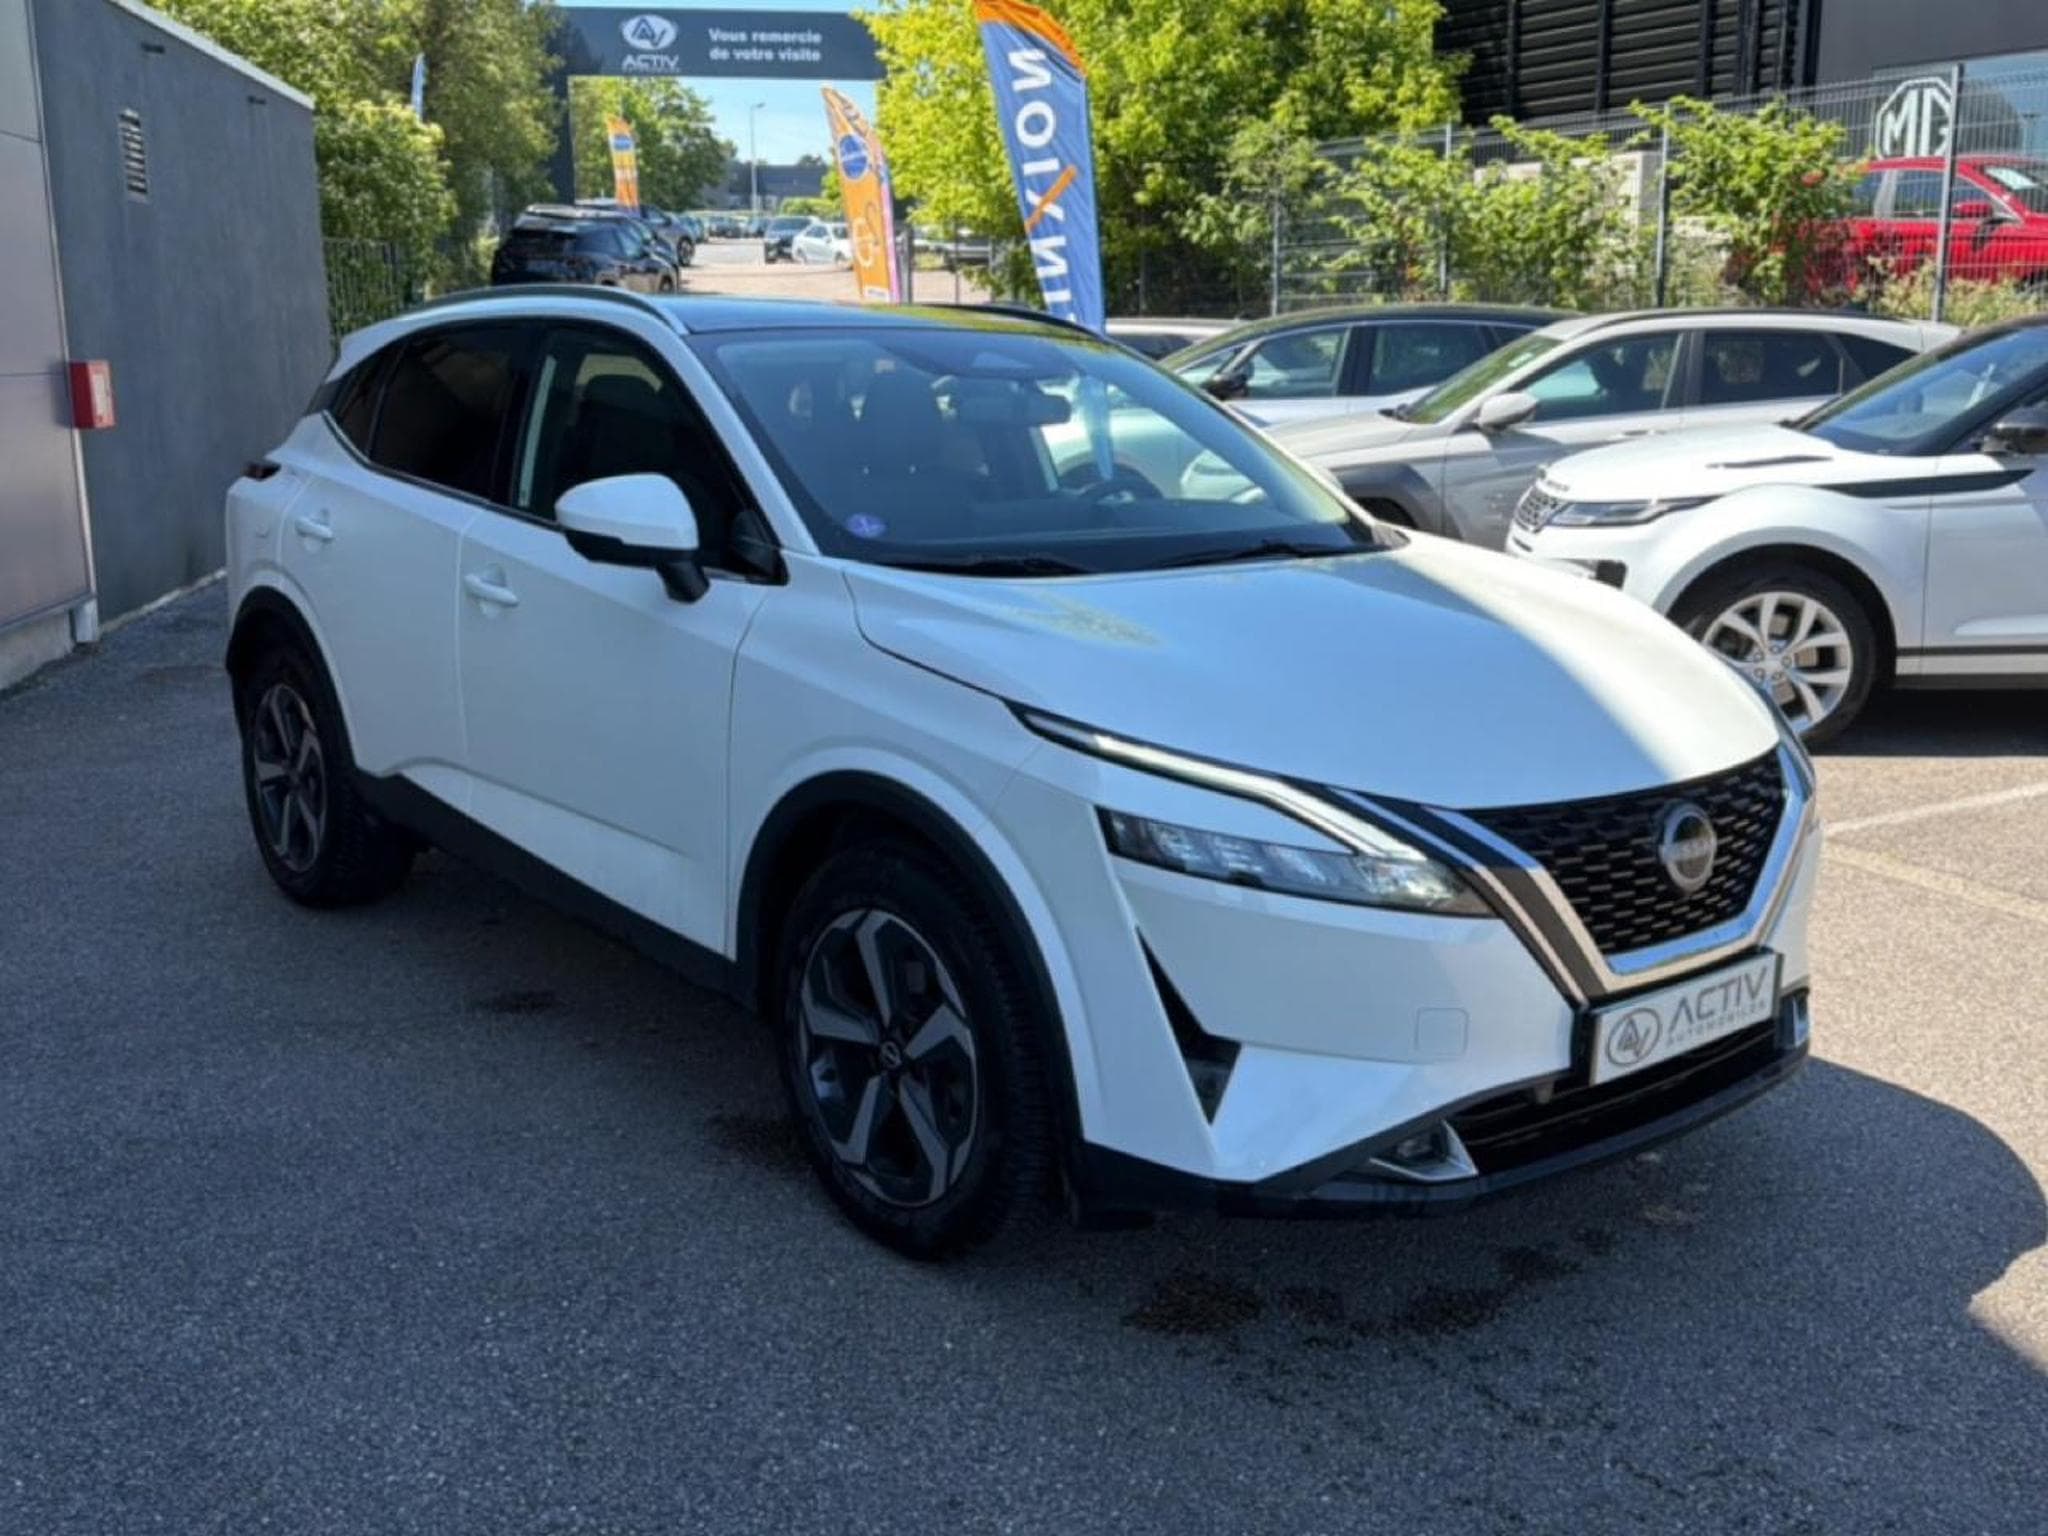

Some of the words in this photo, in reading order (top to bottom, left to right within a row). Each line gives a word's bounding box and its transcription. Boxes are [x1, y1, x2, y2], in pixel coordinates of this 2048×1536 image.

[708, 27, 747, 42] Vous
[752, 29, 822, 42] remercie
[621, 54, 680, 70] ACTIV
[709, 47, 730, 60] de
[732, 48, 774, 60] votre
[778, 48, 821, 61] visite
[1883, 87, 1952, 157] MG
[1668, 965, 1767, 1034] ACTIV
